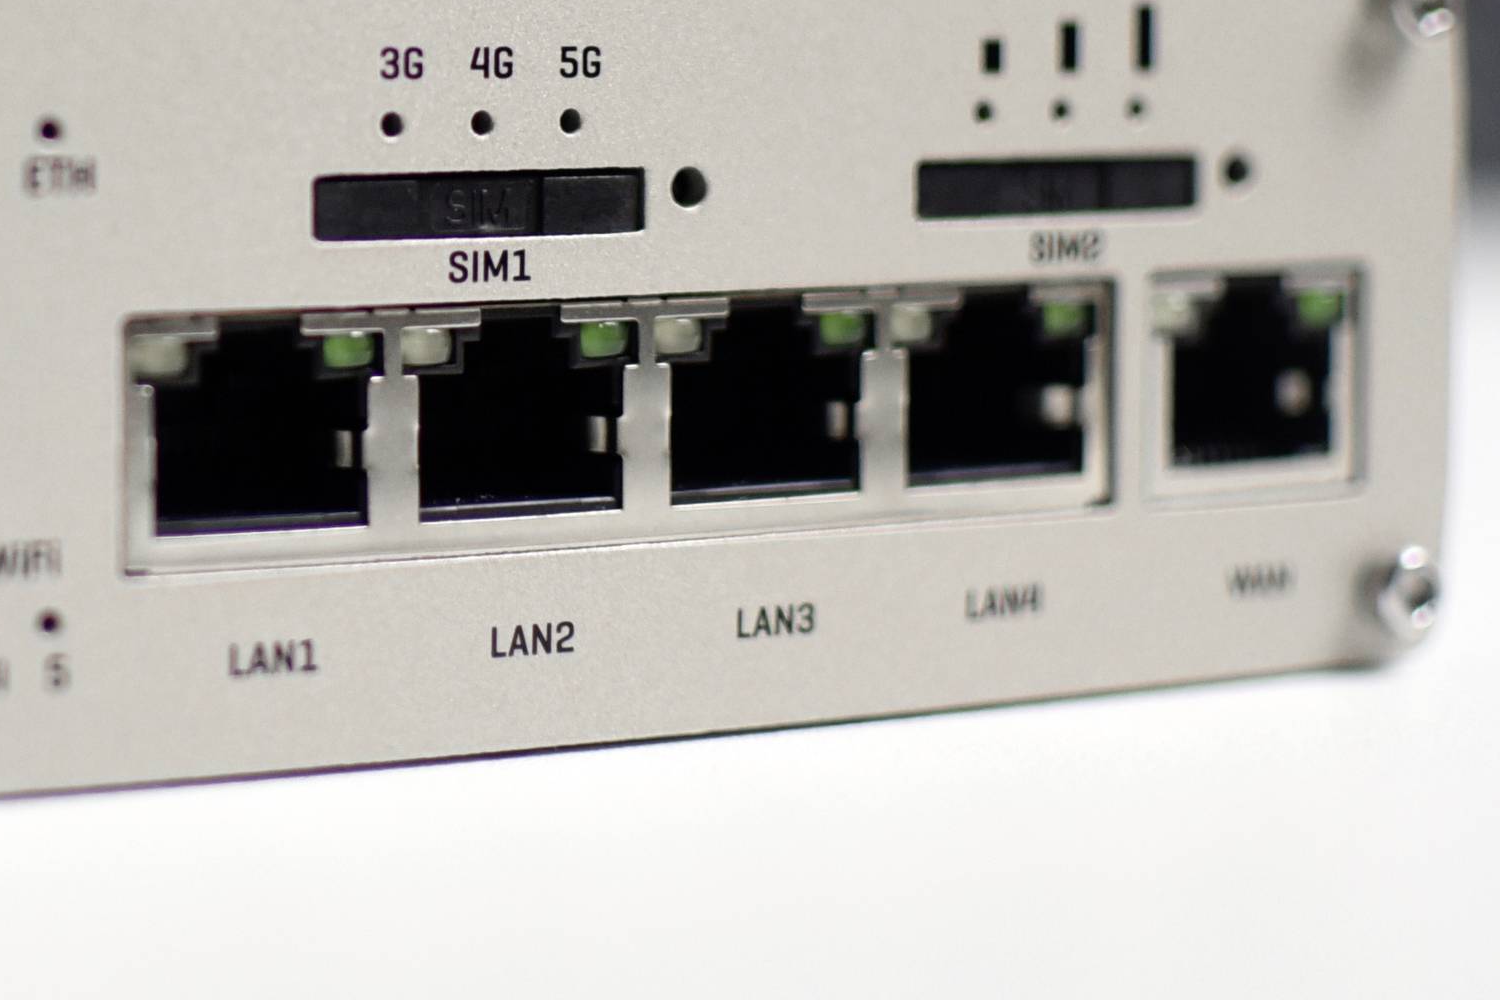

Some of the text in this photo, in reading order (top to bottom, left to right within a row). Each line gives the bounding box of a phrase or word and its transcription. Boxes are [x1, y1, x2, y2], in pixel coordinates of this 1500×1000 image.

[380, 47, 424, 80] 3G
[470, 47, 514, 79] 4G
[559, 46, 601, 78] 5G
[1030, 231, 1102, 263] SIM2
[448, 249, 531, 283] SIM1
[737, 603, 815, 638] LAN3
[491, 621, 575, 659] LAN2
[229, 639, 318, 677] LAN1
